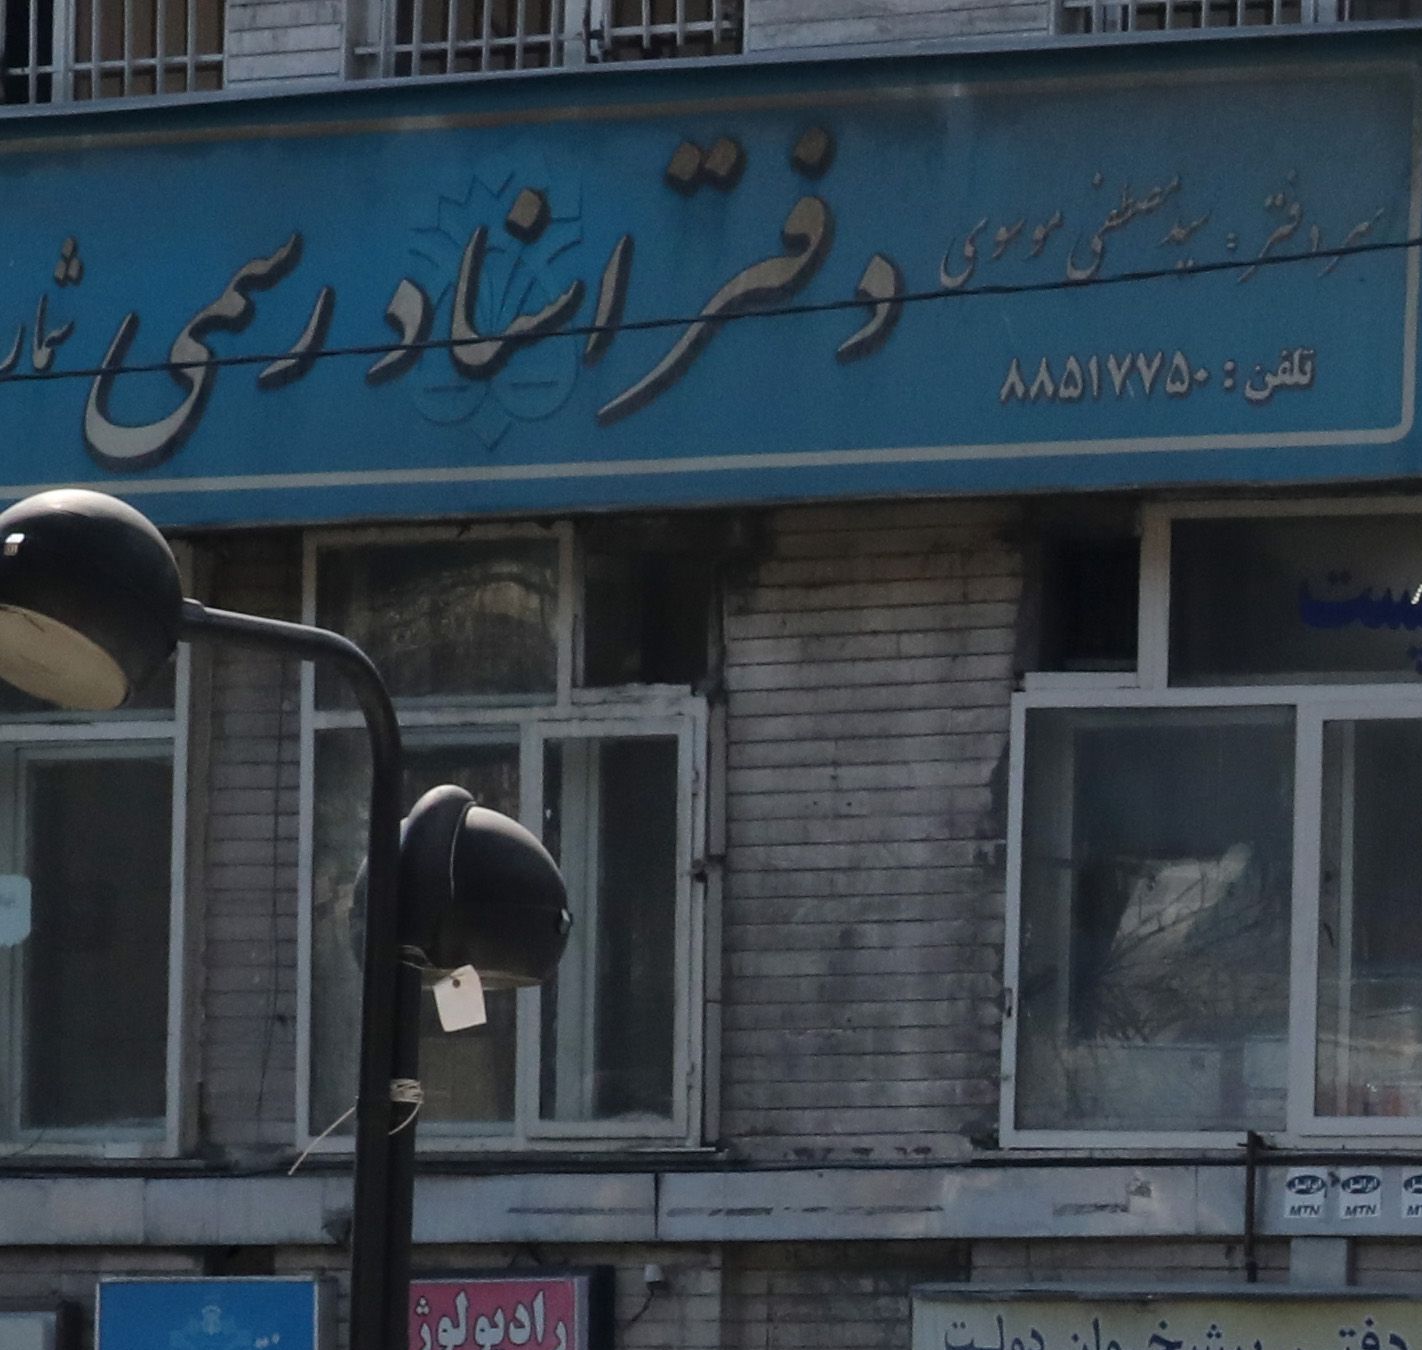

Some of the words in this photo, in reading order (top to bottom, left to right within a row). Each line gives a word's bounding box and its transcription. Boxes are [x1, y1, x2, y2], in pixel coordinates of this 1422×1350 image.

[0, 236, 83, 372] شمار
[367, 186, 634, 386] اسناد
[598, 125, 903, 426] دفتر
[84, 230, 336, 471] رسمی
[1000, 350, 1211, 402] ۸۸۵۱۷۷۵۰
[1243, 347, 1315, 406] تلفن
[1289, 1204, 1320, 1217] MTN
[1344, 1204, 1376, 1217] MTN
